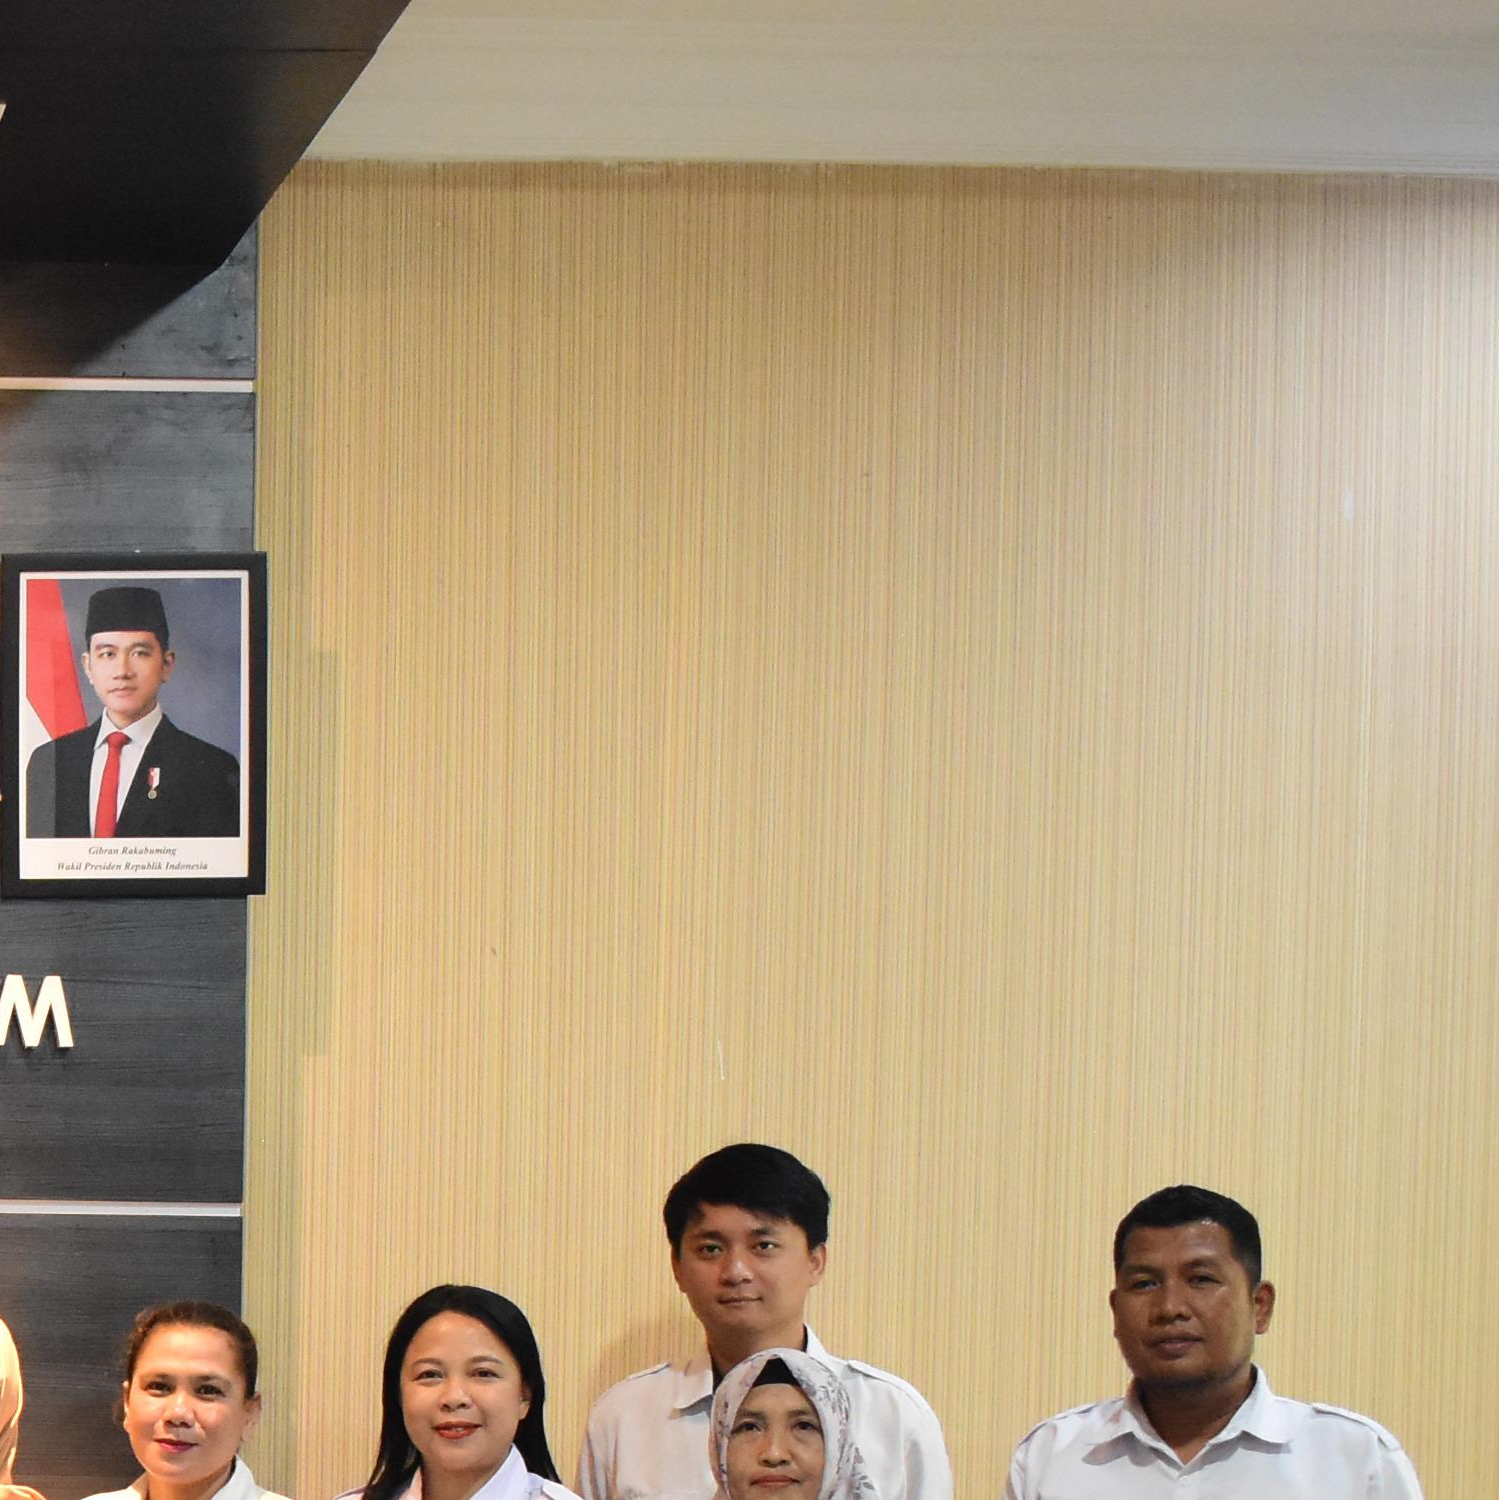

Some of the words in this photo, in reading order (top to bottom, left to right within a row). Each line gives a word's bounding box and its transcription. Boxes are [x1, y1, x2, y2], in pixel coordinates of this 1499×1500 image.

[88, 846, 119, 855] Gibran
[121, 846, 177, 857] Rakabuming
[57, 861, 82, 871] Wakil
[84, 861, 122, 871] Presiden
[124, 861, 163, 873] Republik
[165, 861, 208, 871] Indonesia
